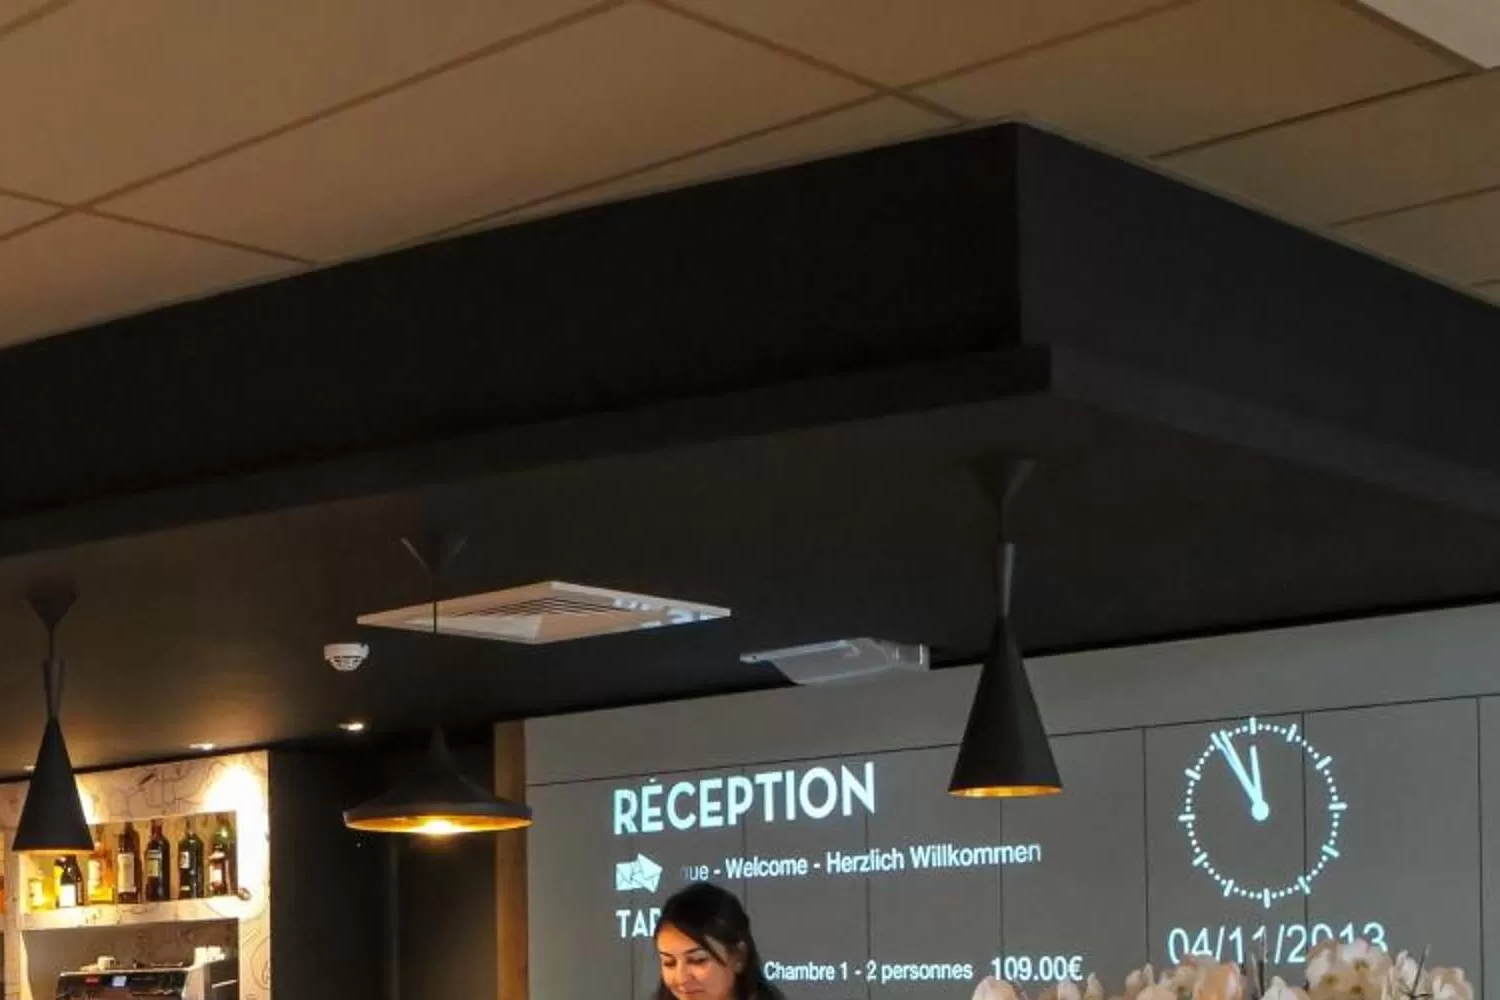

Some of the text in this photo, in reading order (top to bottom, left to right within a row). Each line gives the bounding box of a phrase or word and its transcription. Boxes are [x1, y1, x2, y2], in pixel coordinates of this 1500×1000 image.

[613, 762, 876, 835] RÉCEPTION
[725, 855, 809, 879] Welcome
[826, 847, 905, 874] Herzlich
[909, 843, 1042, 869] Willkommen
[763, 960, 836, 981] Chambre
[839, 961, 848, 980] 1
[866, 960, 877, 980] 2
[880, 962, 974, 984] personnes
[990, 955, 1083, 981] 109.00€
